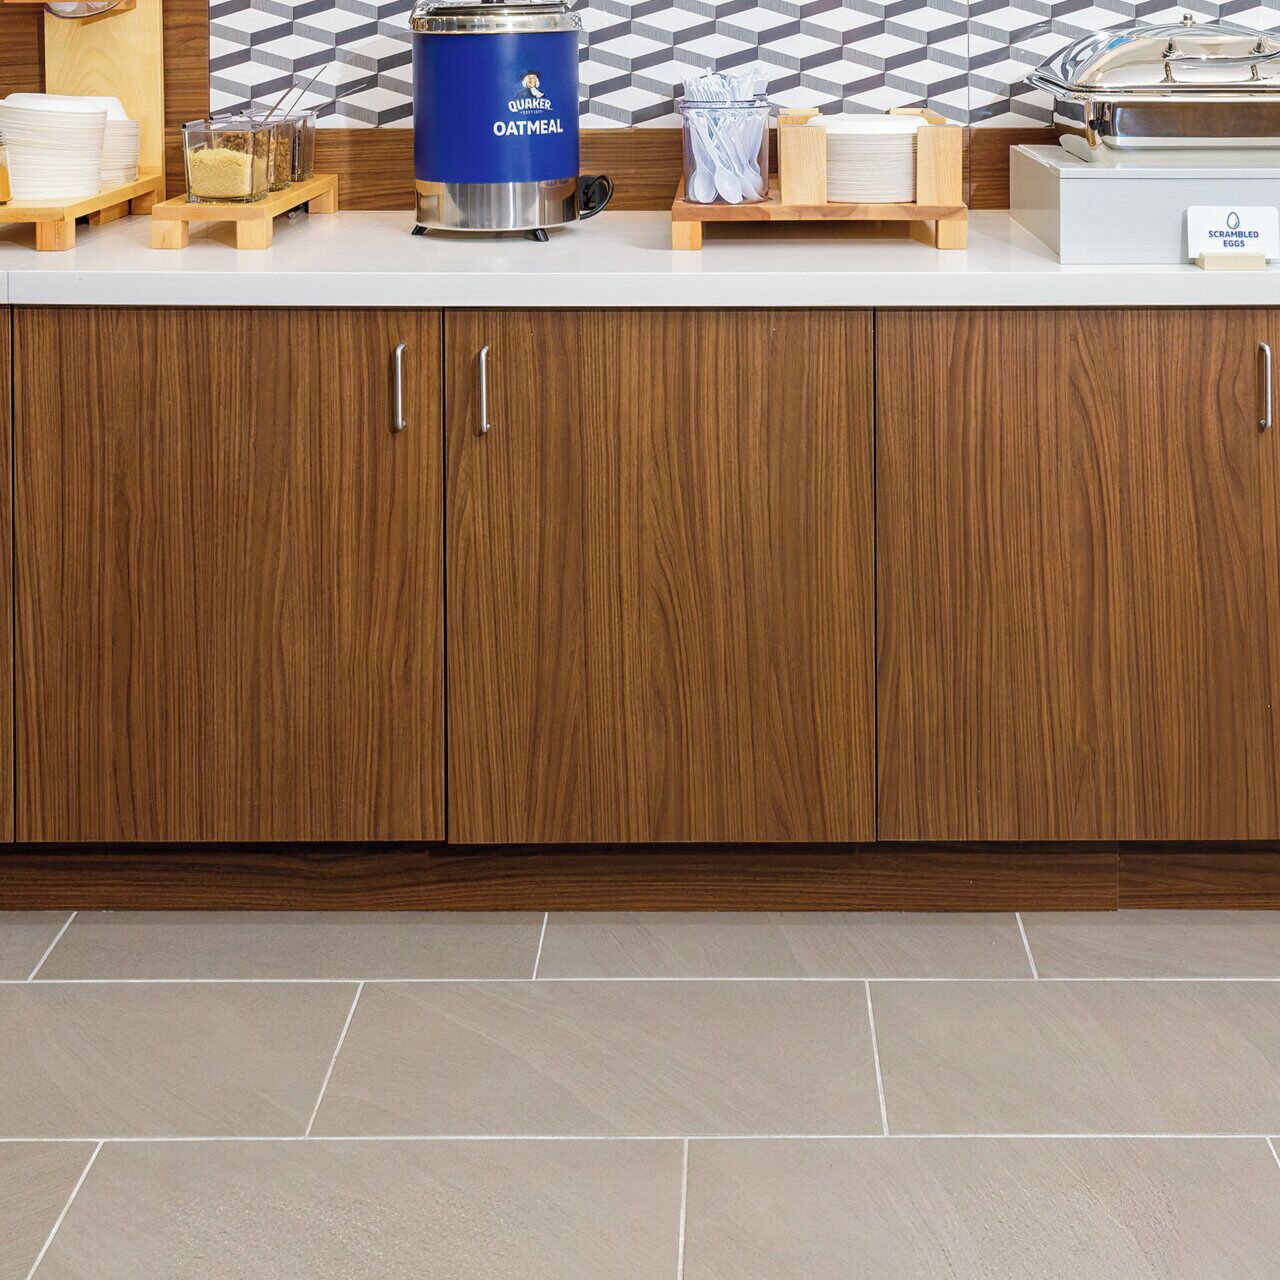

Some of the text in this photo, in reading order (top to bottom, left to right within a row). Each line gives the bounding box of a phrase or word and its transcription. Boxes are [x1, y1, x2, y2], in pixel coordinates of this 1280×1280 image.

[508, 98, 552, 113] QUAKER
[493, 119, 564, 137] OATMEAL
[1208, 230, 1259, 239] SCRAMBLED
[1223, 239, 1246, 248] EGGS
